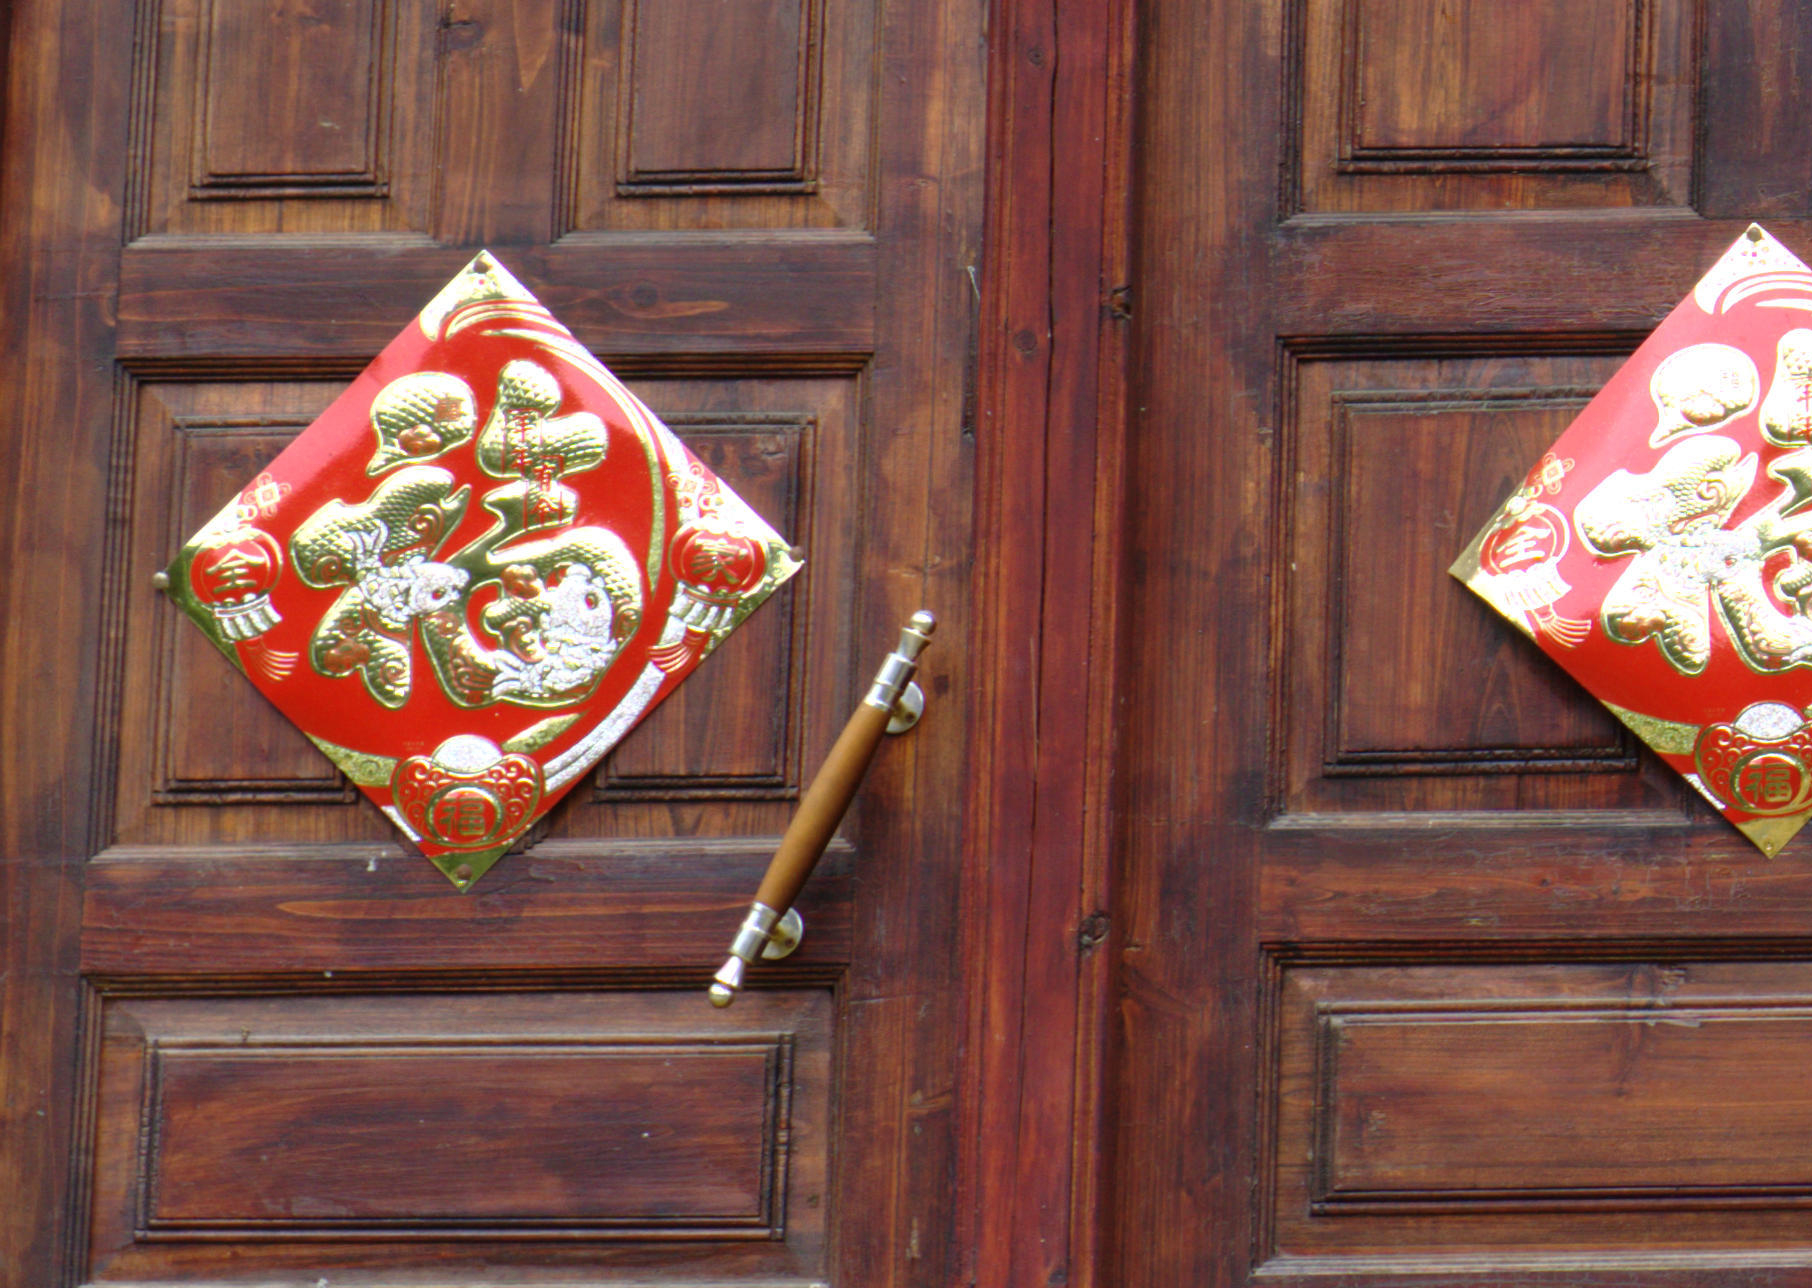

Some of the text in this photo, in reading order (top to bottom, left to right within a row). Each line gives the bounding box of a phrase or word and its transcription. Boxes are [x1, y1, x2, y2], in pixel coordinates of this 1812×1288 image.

[1496, 525, 1552, 569] 全
[205, 548, 266, 594] 全
[1745, 763, 1792, 803] 福
[440, 796, 486, 837] 福
